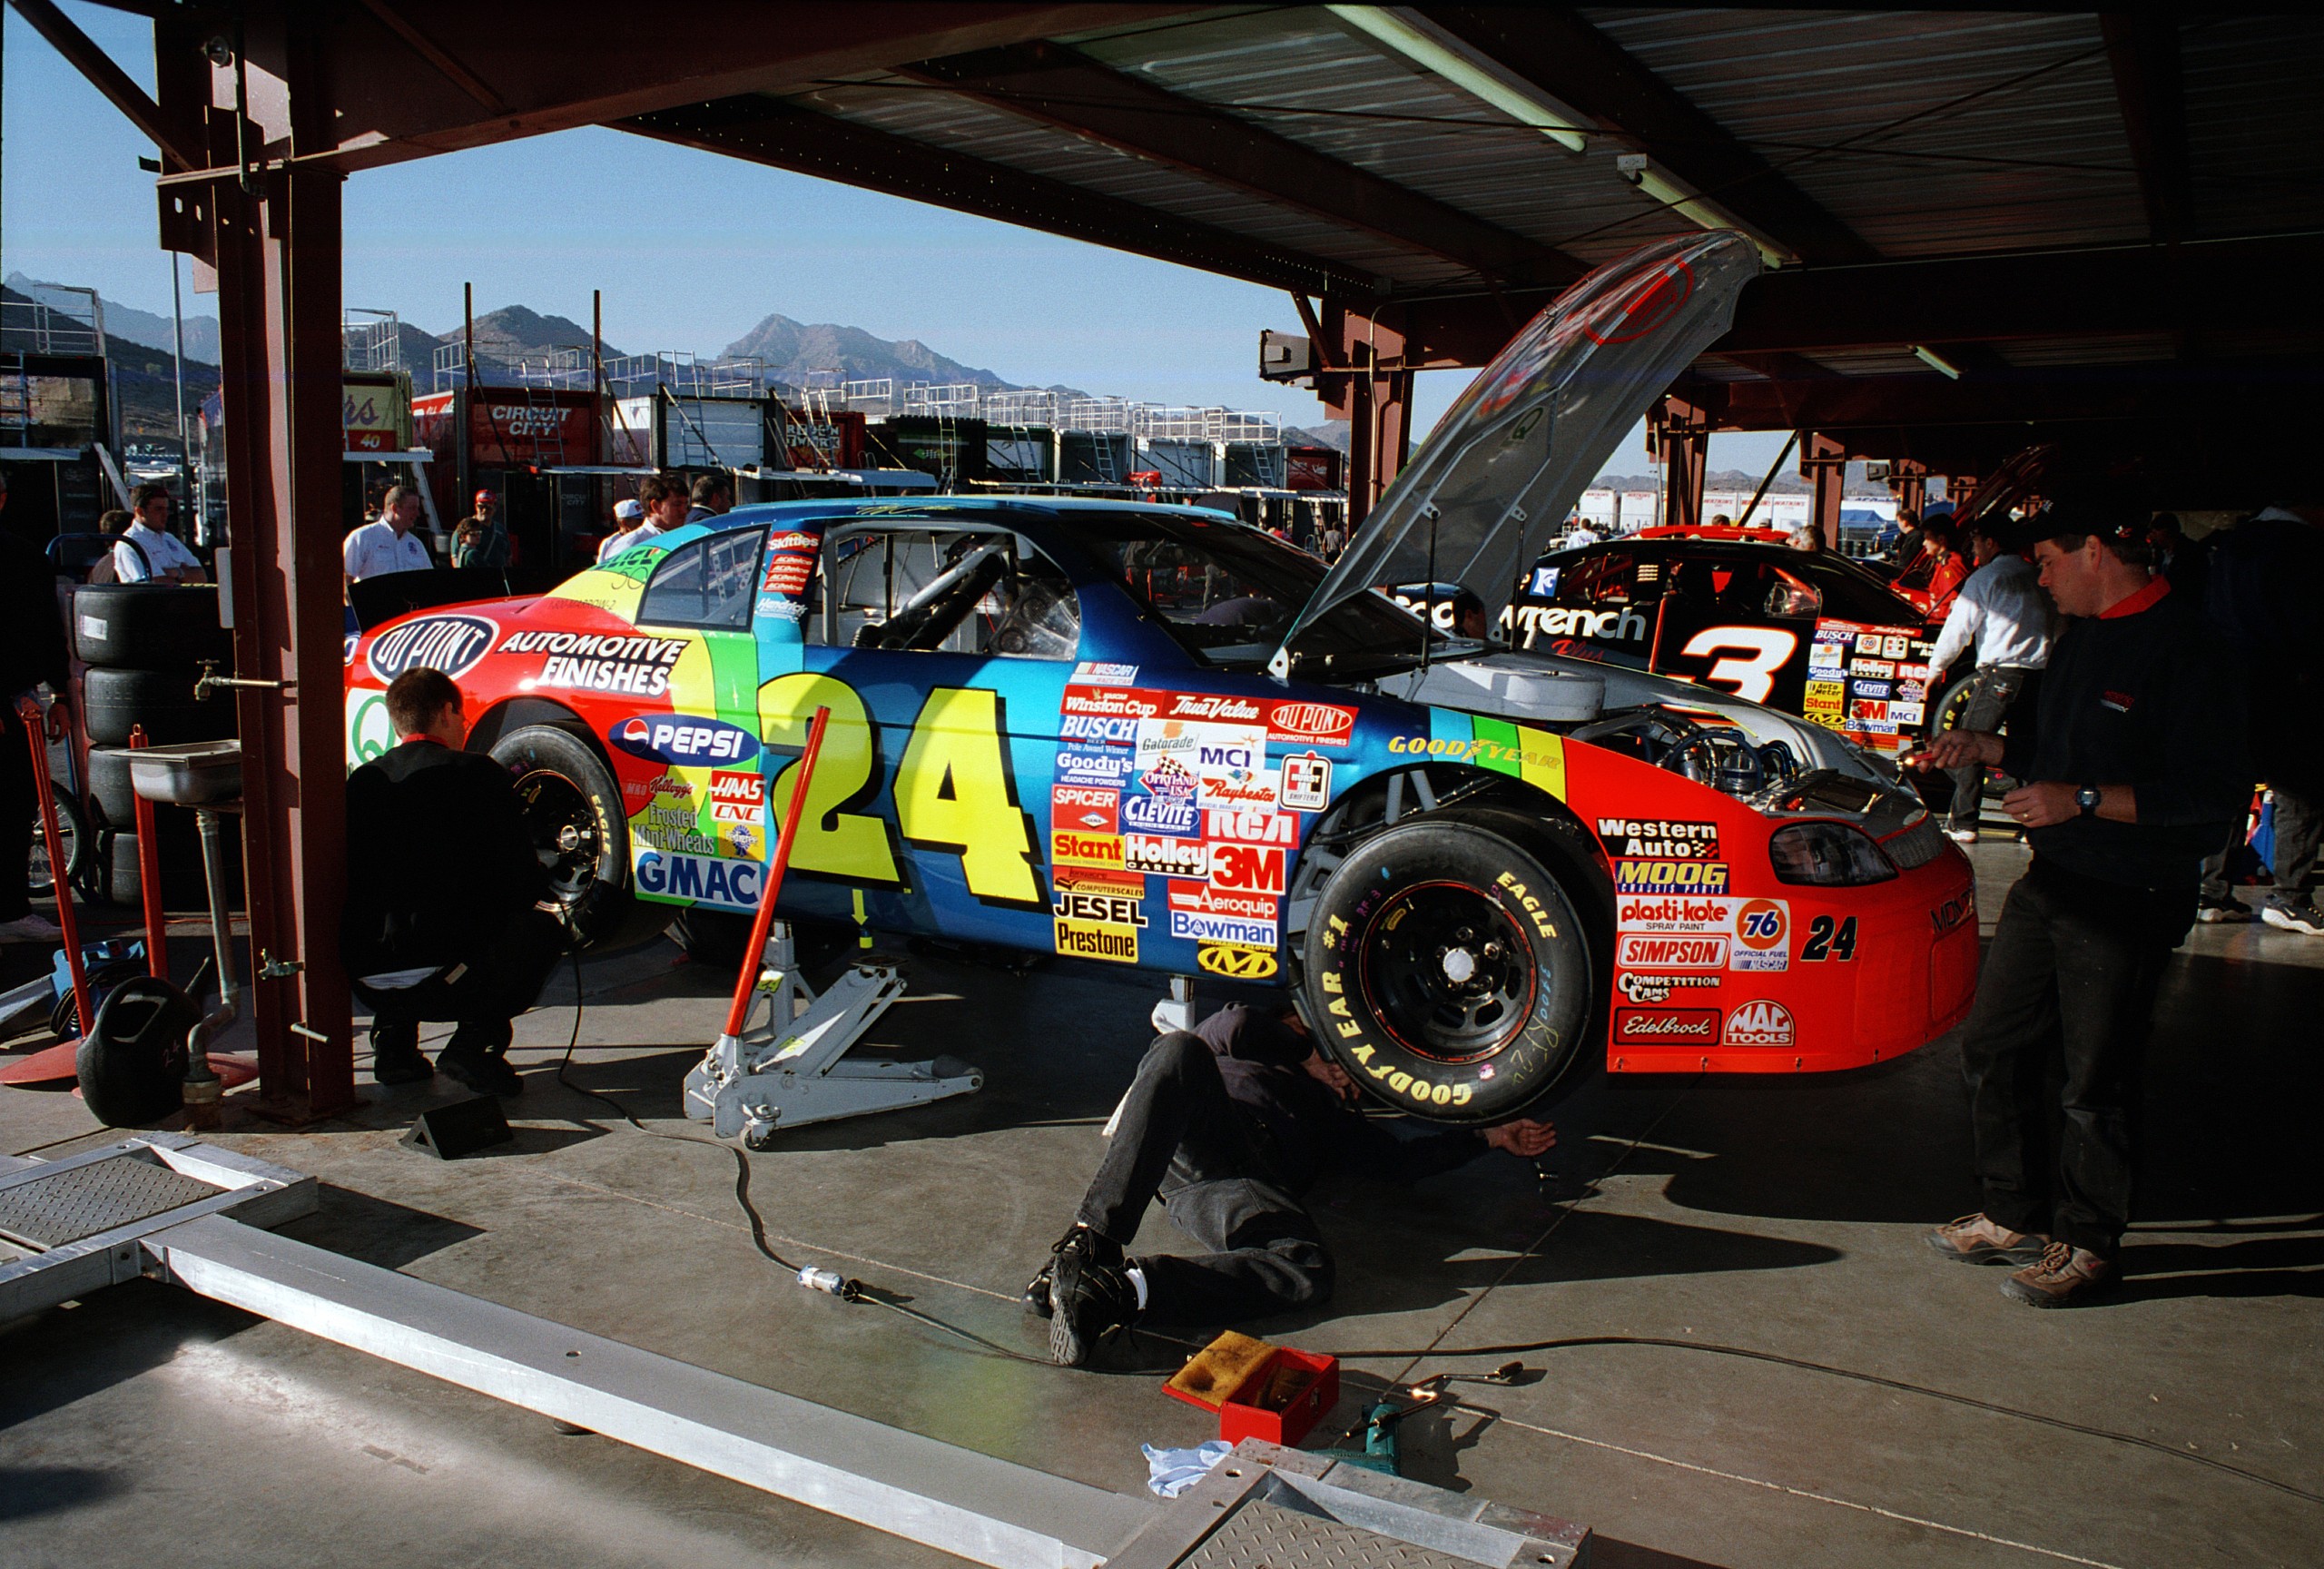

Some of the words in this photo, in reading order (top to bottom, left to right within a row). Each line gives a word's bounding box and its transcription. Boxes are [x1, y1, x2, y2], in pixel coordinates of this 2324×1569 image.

[493, 406, 572, 421] CIRCUIT
[509, 421, 555, 436] CITY
[360, 433, 380, 449] 40
[768, 536, 819, 550] Skittles
[611, 567, 649, 590] 50
[1815, 630, 1855, 641] BUSCH
[498, 632, 687, 664] AUTOMOTIVE
[1094, 664, 1134, 677] NASCAR
[1667, 624, 1799, 705] 3
[1854, 660, 1892, 674] Holley
[1898, 665, 1929, 678] RC
[539, 657, 670, 696] FINISHES
[1853, 681, 1889, 695] CLEVITE
[1066, 696, 1125, 715] Winston
[1125, 699, 1157, 718] Cup
[1806, 697, 1843, 710] Stant
[1852, 700, 1887, 720] 3M
[1060, 715, 1138, 741] BUSCH
[1846, 719, 1896, 733] Bowman
[1890, 712, 1916, 722] MCI
[652, 725, 744, 758] PEPSI
[1068, 743, 1082, 752] Pole
[1082, 745, 1104, 753] Award
[1105, 745, 1129, 755] Winner
[1142, 736, 1194, 752] Gatorade
[1265, 733, 1315, 744] AUTOMOTIVE
[1315, 735, 1347, 745] FINISHES
[1057, 753, 1134, 774] Goody's
[1200, 747, 1251, 768] MCI
[650, 775, 693, 799] Kellogg's
[708, 777, 766, 800] HAAS
[757, 673, 1044, 906] 24
[1060, 775, 1093, 785] HEADACHE
[1094, 778, 1127, 788] POWDERS
[1170, 785, 1191, 797] USA
[1201, 778, 1275, 804] Raybestos
[1054, 789, 1117, 808] SPICER
[1125, 795, 1196, 825] CLEVITE
[592, 794, 611, 855] EAGLE
[649, 801, 697, 828] Frosted
[715, 804, 762, 822] CNC
[633, 823, 714, 854] Mini-Wheats
[1208, 810, 1293, 844] RCA
[1599, 818, 1718, 840] Western
[1055, 834, 1123, 862] Stant
[1128, 836, 1209, 875] Holley
[1624, 838, 1692, 857] Auto
[636, 852, 759, 905] GMAC
[1127, 862, 1187, 874] CARBS
[1213, 845, 1283, 893] 3M
[1618, 862, 1728, 885] MOOG
[1620, 883, 1676, 893] CHASSIS
[1684, 884, 1725, 894] PARTS
[1055, 894, 1147, 926] JESEL
[1196, 885, 1276, 918] Aeroquip
[1496, 871, 1557, 939] EAGLE
[1621, 899, 1728, 923] plasti-kote
[1173, 913, 1275, 944] Bowman
[1323, 913, 1348, 950] #1
[1646, 922, 1676, 931] SPRAY
[1679, 923, 1706, 931] PAINT
[1744, 911, 1779, 939] 76
[1058, 923, 1135, 958] Prestone
[1800, 915, 1857, 962] 24
[1626, 940, 1720, 964] SIMPSON
[1750, 959, 1787, 971] NASCAR
[1623, 1016, 1710, 1037] Edelbrock
[1728, 1002, 1791, 1033] MAC
[1322, 971, 1472, 1105] GOODYEAR
[1728, 1032, 1790, 1044] TOOLS
